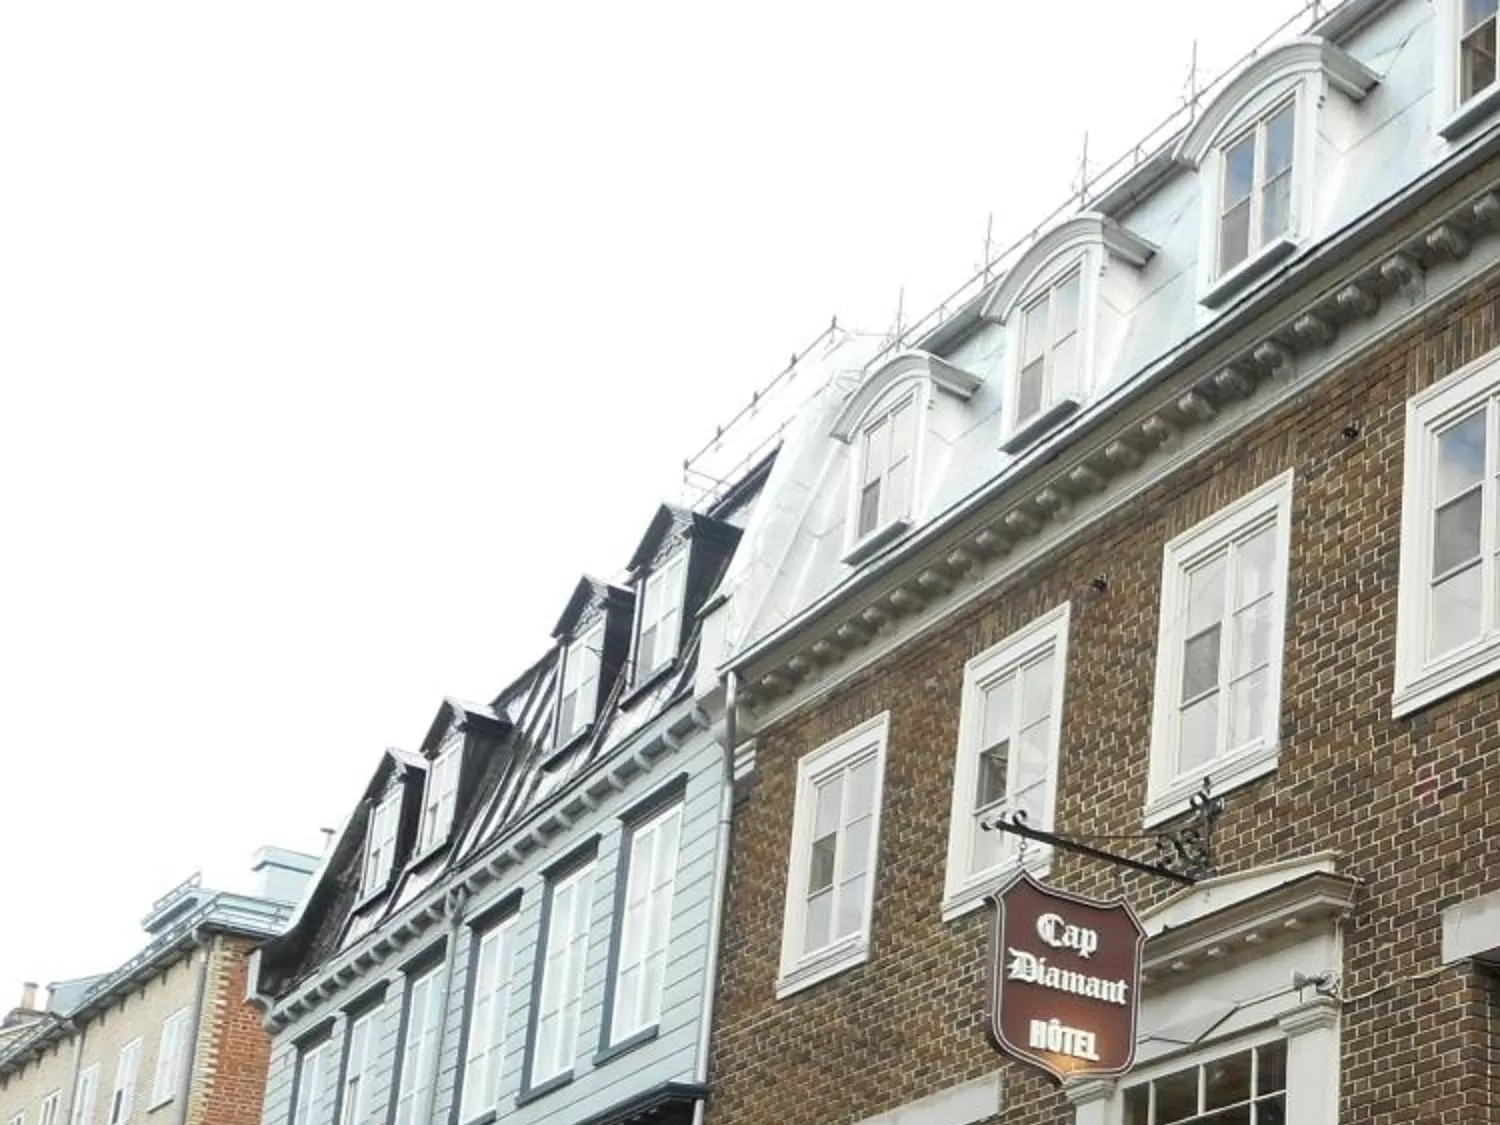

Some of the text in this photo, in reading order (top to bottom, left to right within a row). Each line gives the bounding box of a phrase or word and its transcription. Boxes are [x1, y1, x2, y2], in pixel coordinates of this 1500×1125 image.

[1036, 913, 1098, 958] Cap
[1006, 947, 1128, 1005] Diamant
[1029, 1018, 1100, 1061] HÔTEL
